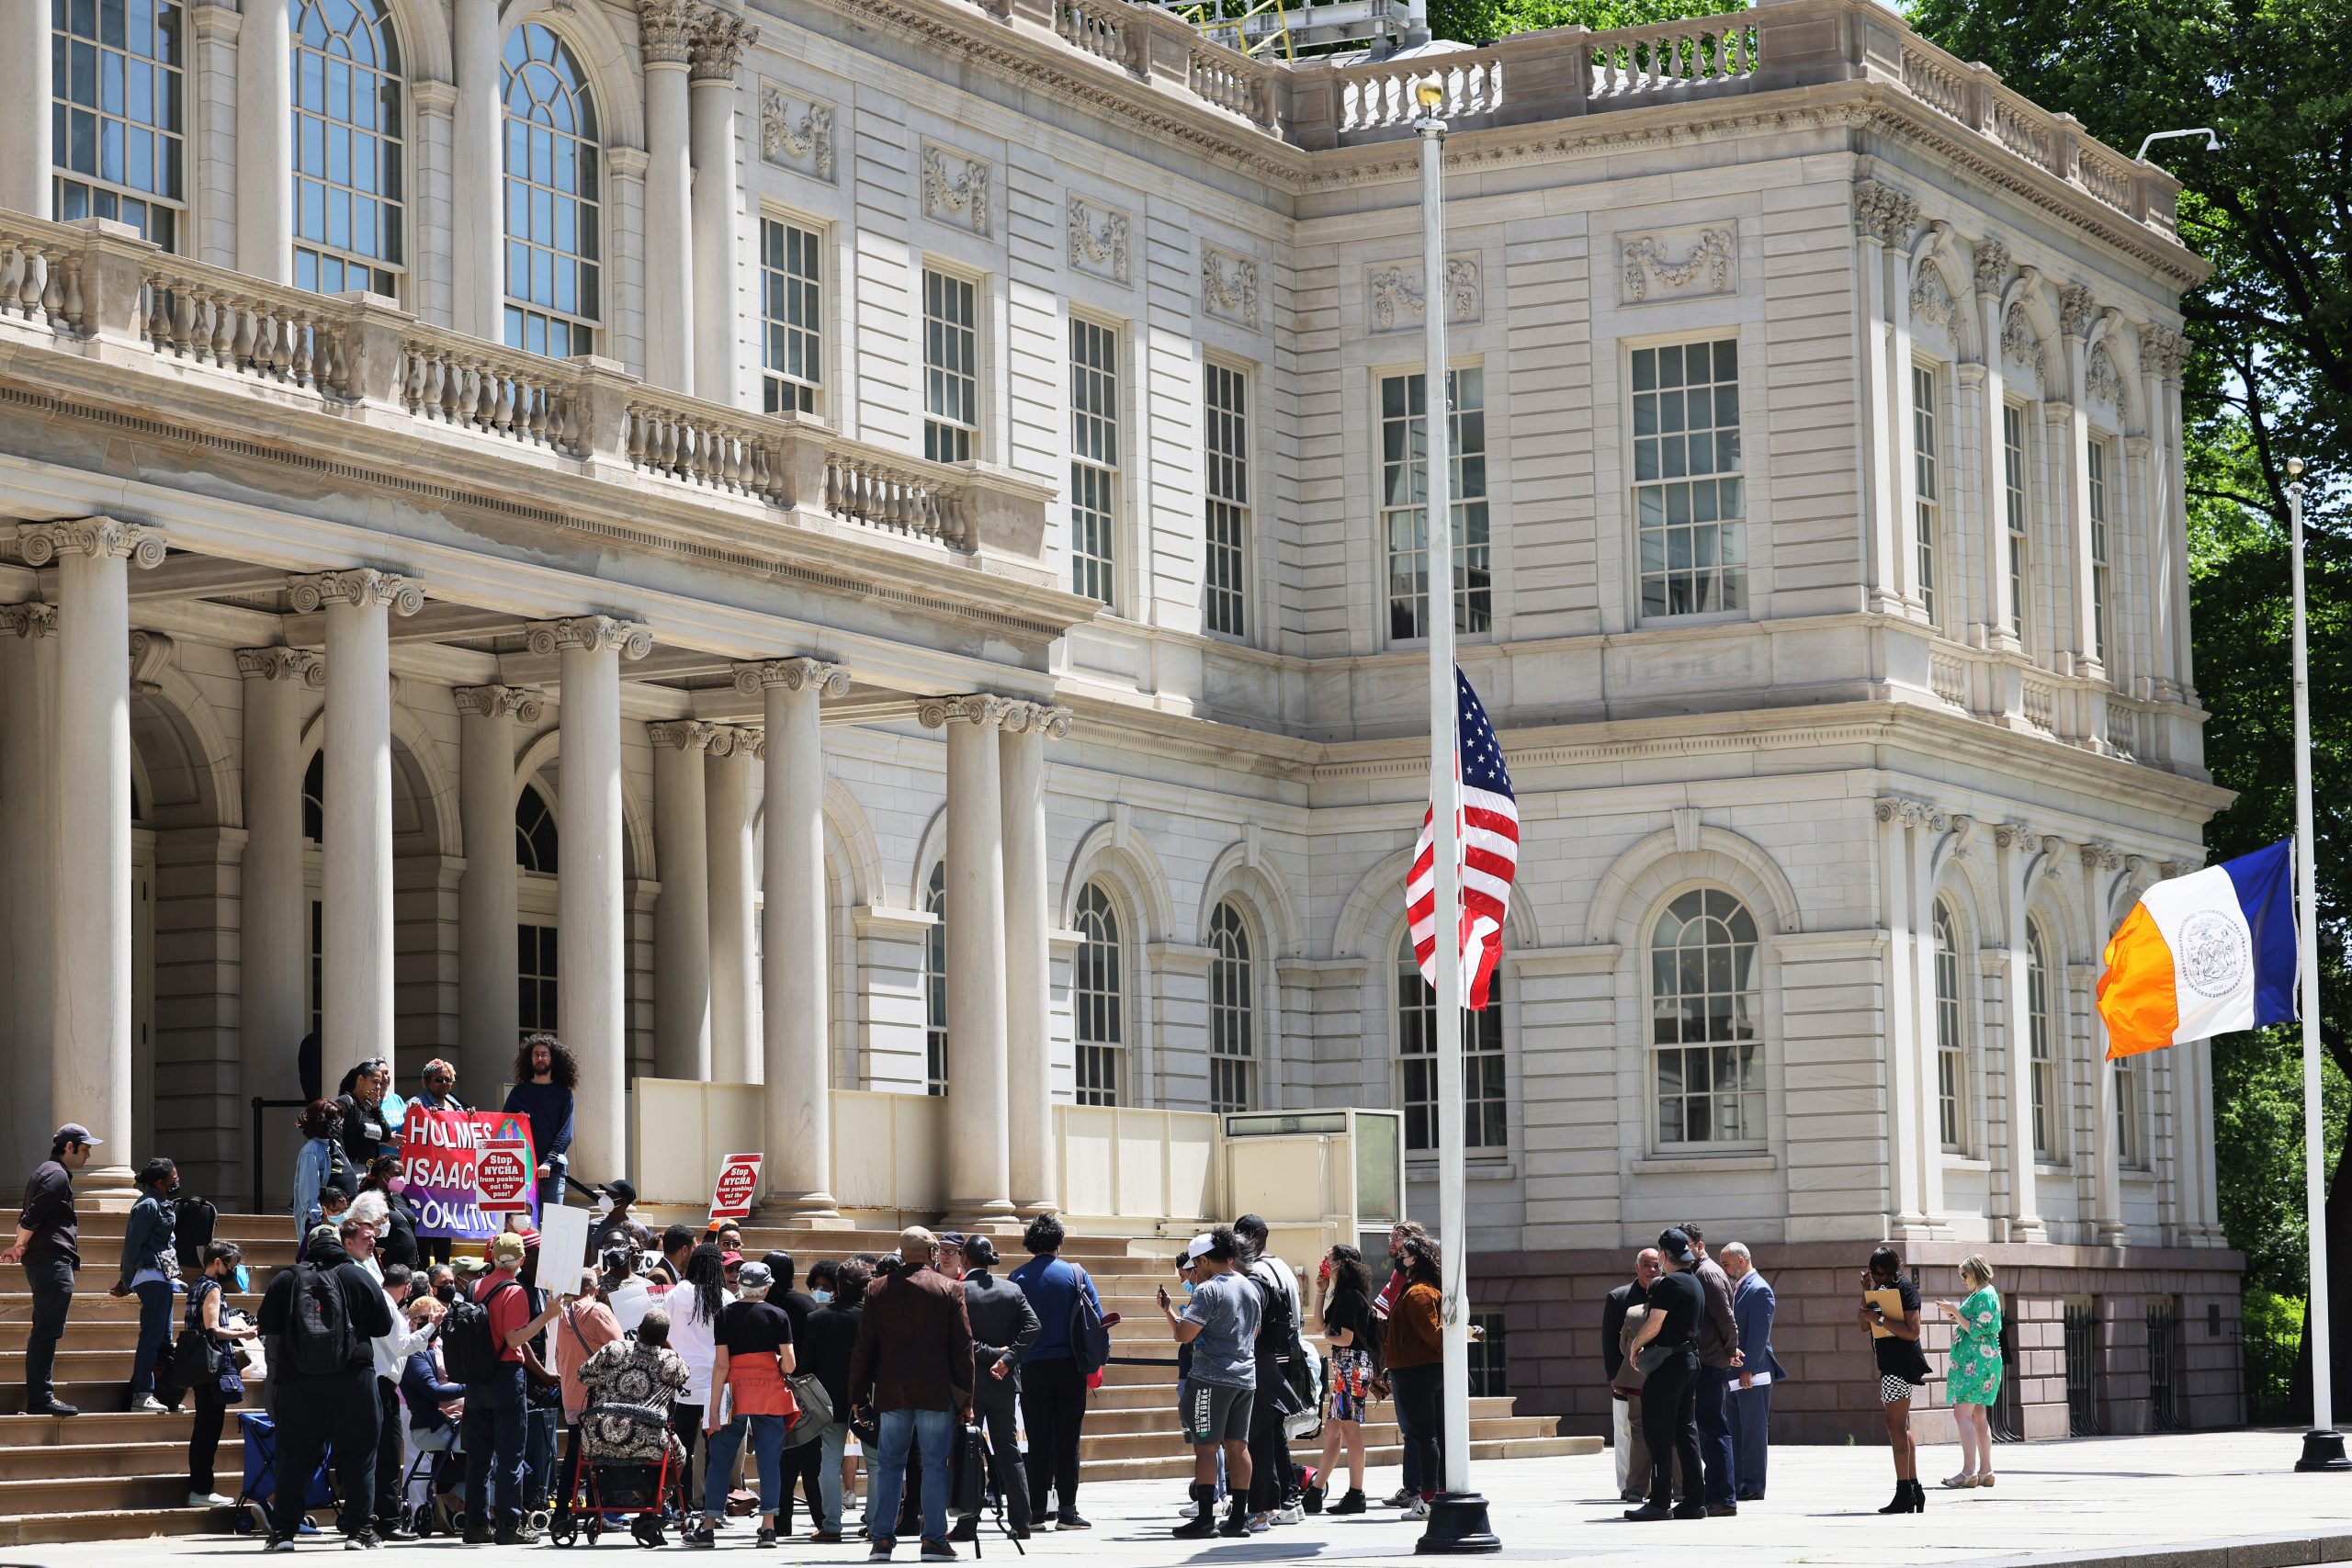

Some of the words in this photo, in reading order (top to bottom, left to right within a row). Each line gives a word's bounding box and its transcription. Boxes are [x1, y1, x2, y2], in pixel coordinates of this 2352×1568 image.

[411, 1116, 492, 1148] HOLMES
[490, 1155, 513, 1166] Stop
[404, 1157, 477, 1190] ISAAC
[484, 1166, 518, 1175] NYCHA
[730, 1168, 749, 1177] Stop
[724, 1177, 751, 1185] NYCHA
